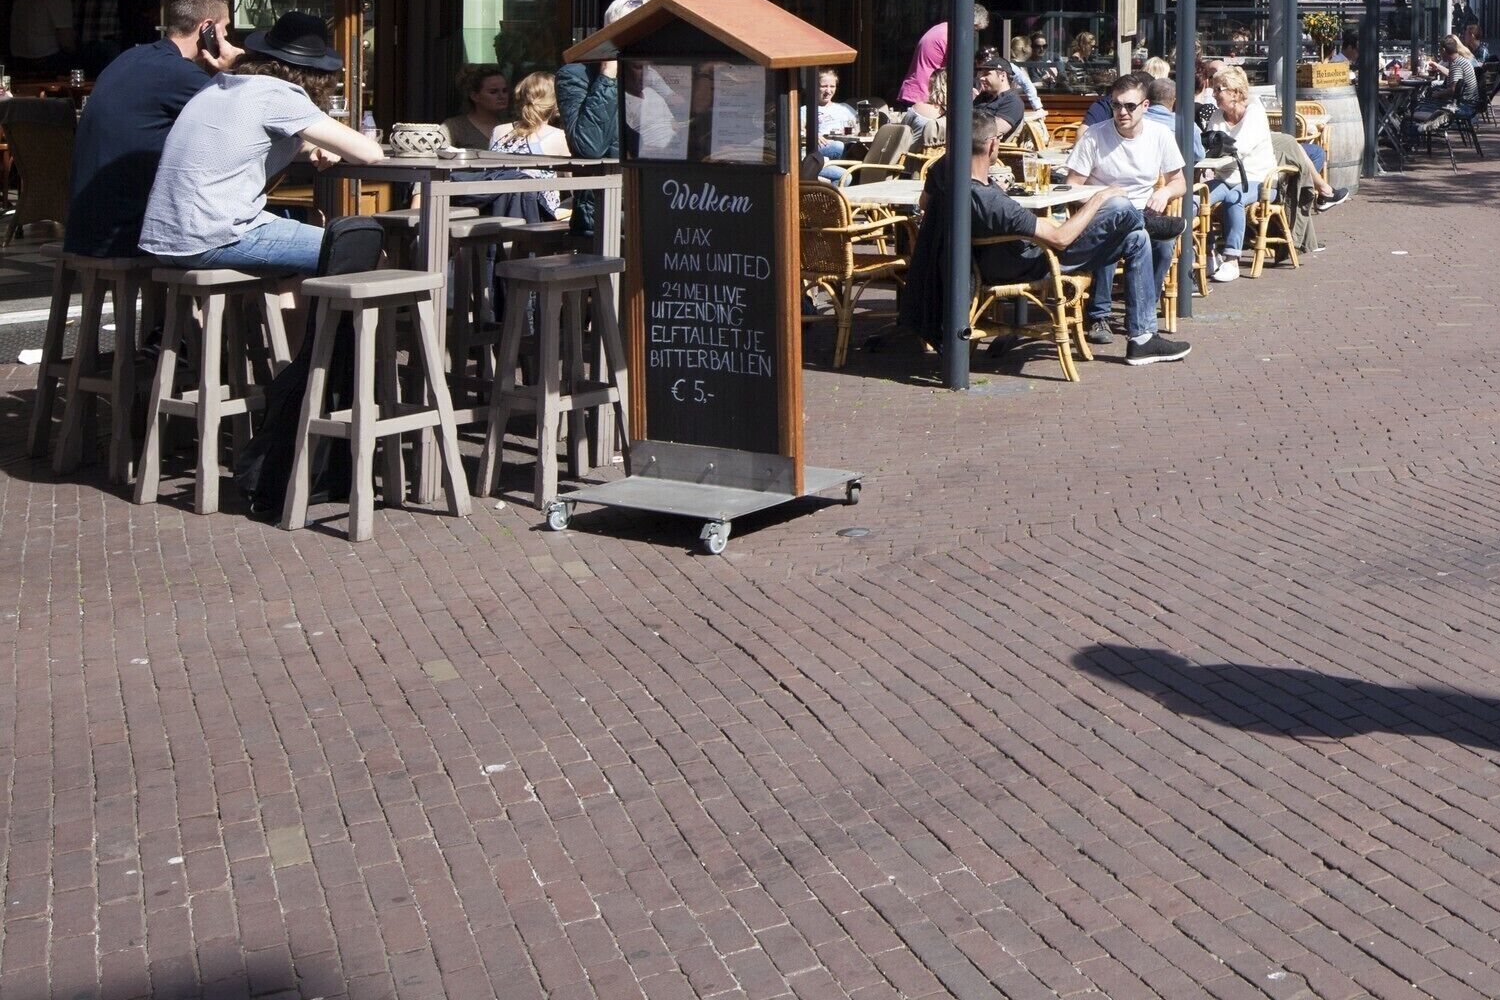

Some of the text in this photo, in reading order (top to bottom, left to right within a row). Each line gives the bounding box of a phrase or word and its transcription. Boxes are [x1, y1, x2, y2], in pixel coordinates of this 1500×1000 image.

[662, 179, 753, 213] Welkom
[673, 228, 712, 246] AJAX
[664, 253, 771, 280] MAN UNITED
[662, 281, 747, 307] 24 MEI LIVE
[651, 301, 744, 326] UITZENDING
[651, 325, 766, 353] ELFTALLETJE
[650, 349, 772, 377] BITTERBALLEN
[671, 379, 686, 402] €
